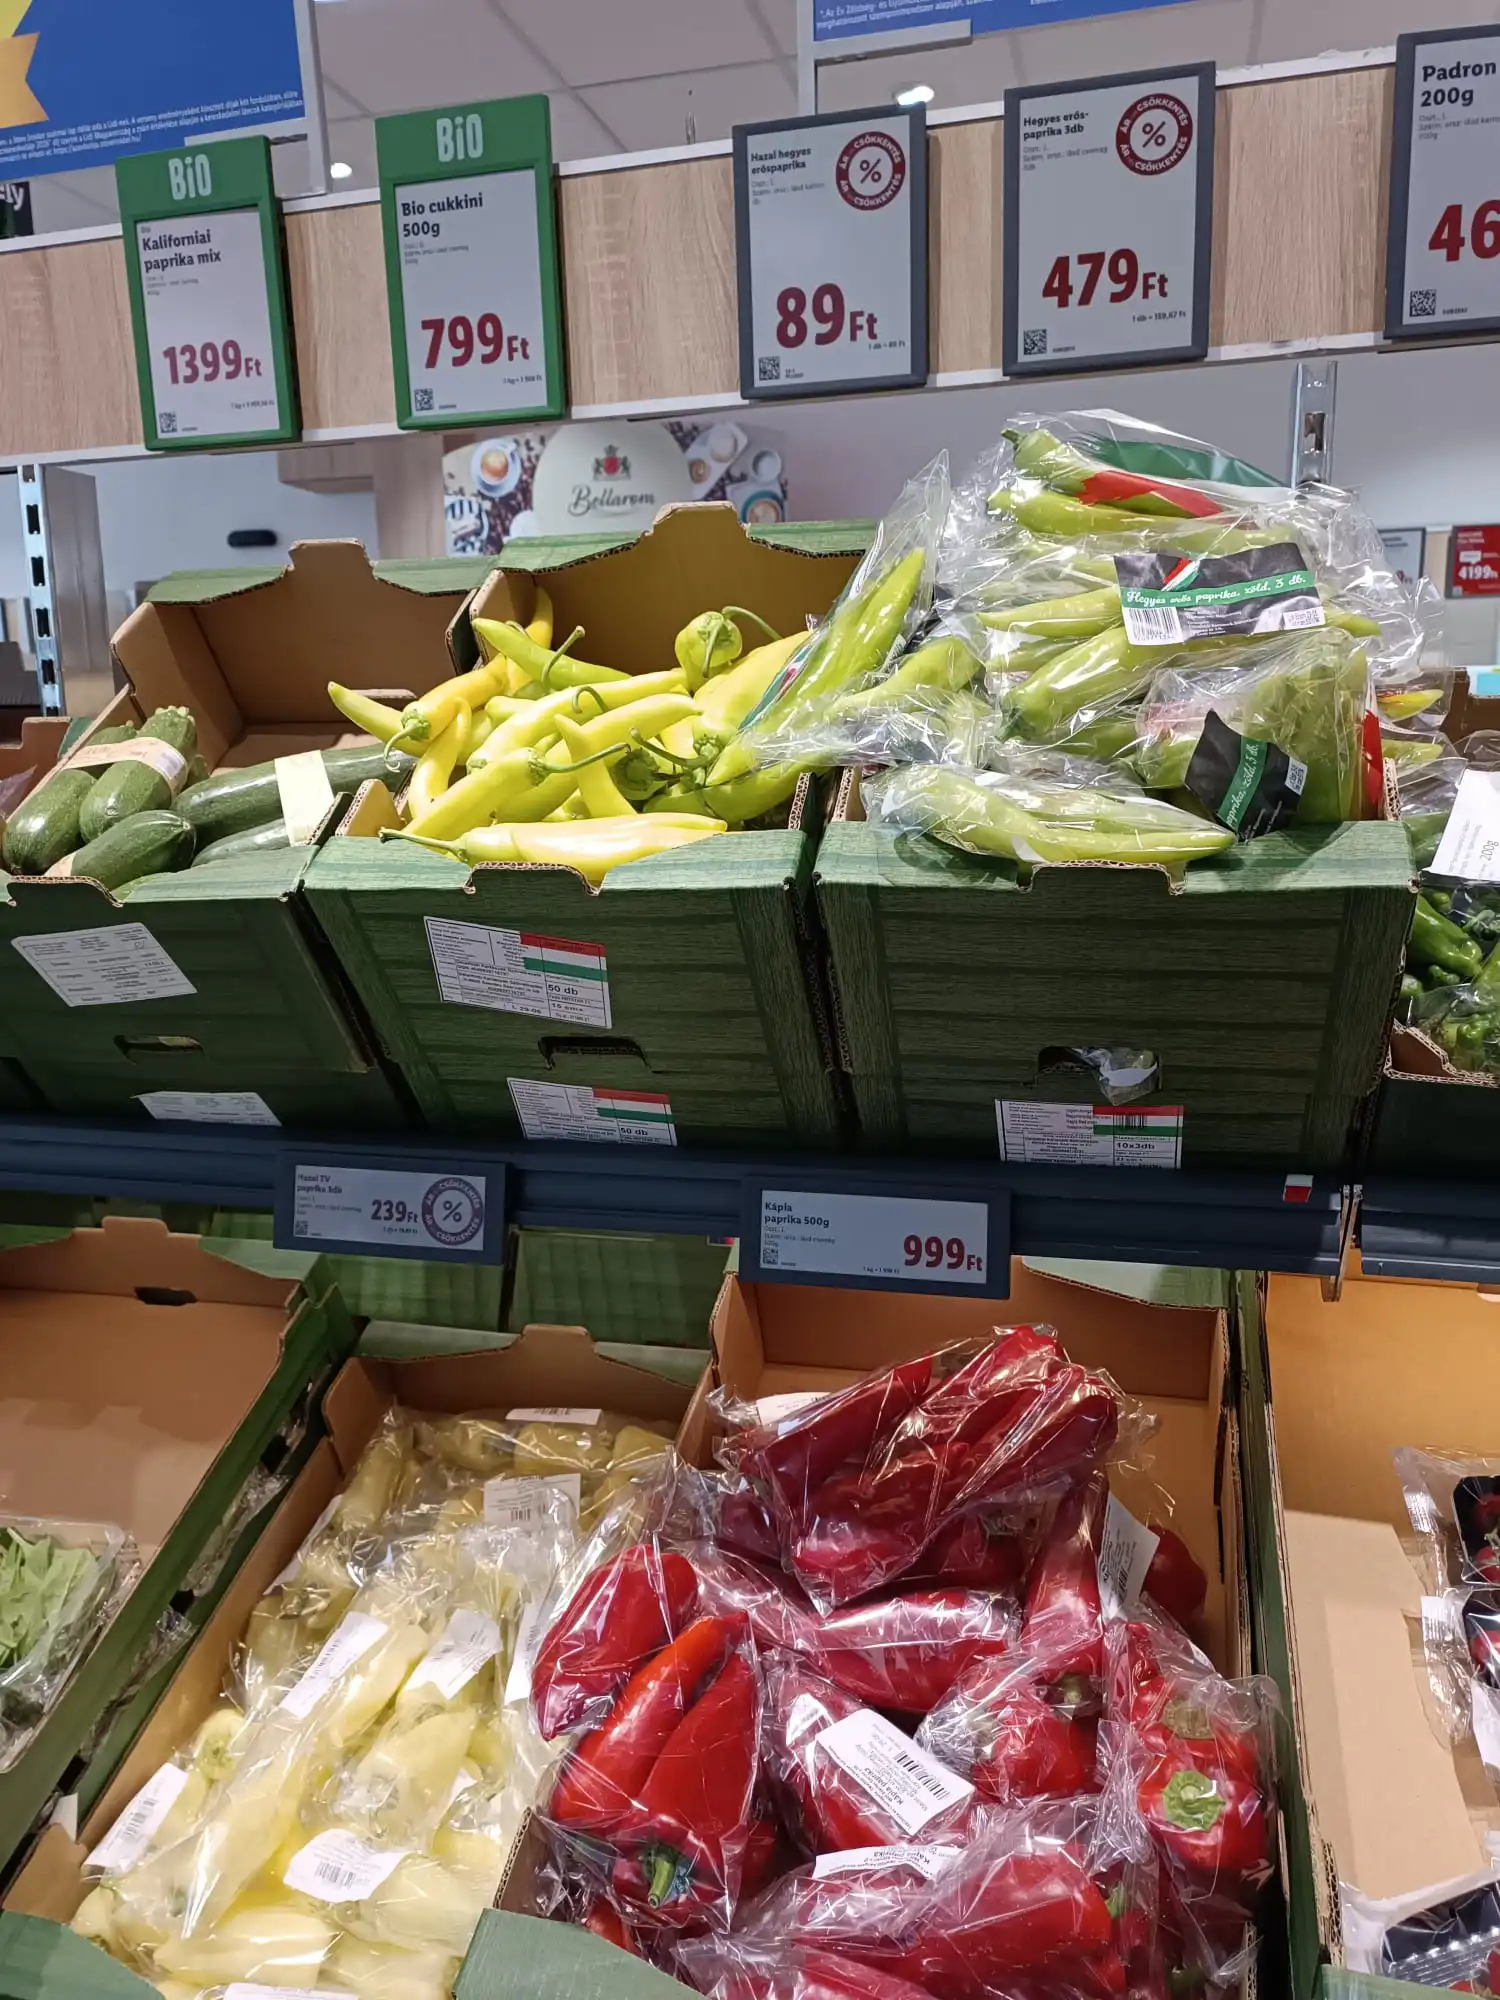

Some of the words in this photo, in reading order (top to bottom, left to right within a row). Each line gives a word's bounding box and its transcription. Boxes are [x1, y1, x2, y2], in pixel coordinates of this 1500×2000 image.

[1422, 61, 1496, 82] Padron
[1420, 87, 1474, 107] 200g
[1023, 115, 1061, 128] Hegyes
[1023, 126, 1062, 141] paprika
[1064, 123, 1085, 136] 3db
[778, 147, 812, 160] hegyes
[401, 201, 425, 217] Bio
[429, 192, 483, 213] cukkini
[402, 221, 440, 238] 500g
[142, 229, 212, 252] Kaliforniai
[144, 252, 194, 274] paprika
[197, 249, 222, 264] mix
[568, 484, 655, 516] Bellarom
[1126, 590, 1166, 606] Hegyes
[1480, 840, 1499, 861] 200g
[548, 984, 560, 992] 50
[564, 987, 578, 995] db
[320, 1174, 331, 1182] TV
[765, 1202, 792, 1213] Kápia
[764, 1214, 802, 1225] paprika
[804, 1216, 829, 1228] 500g
